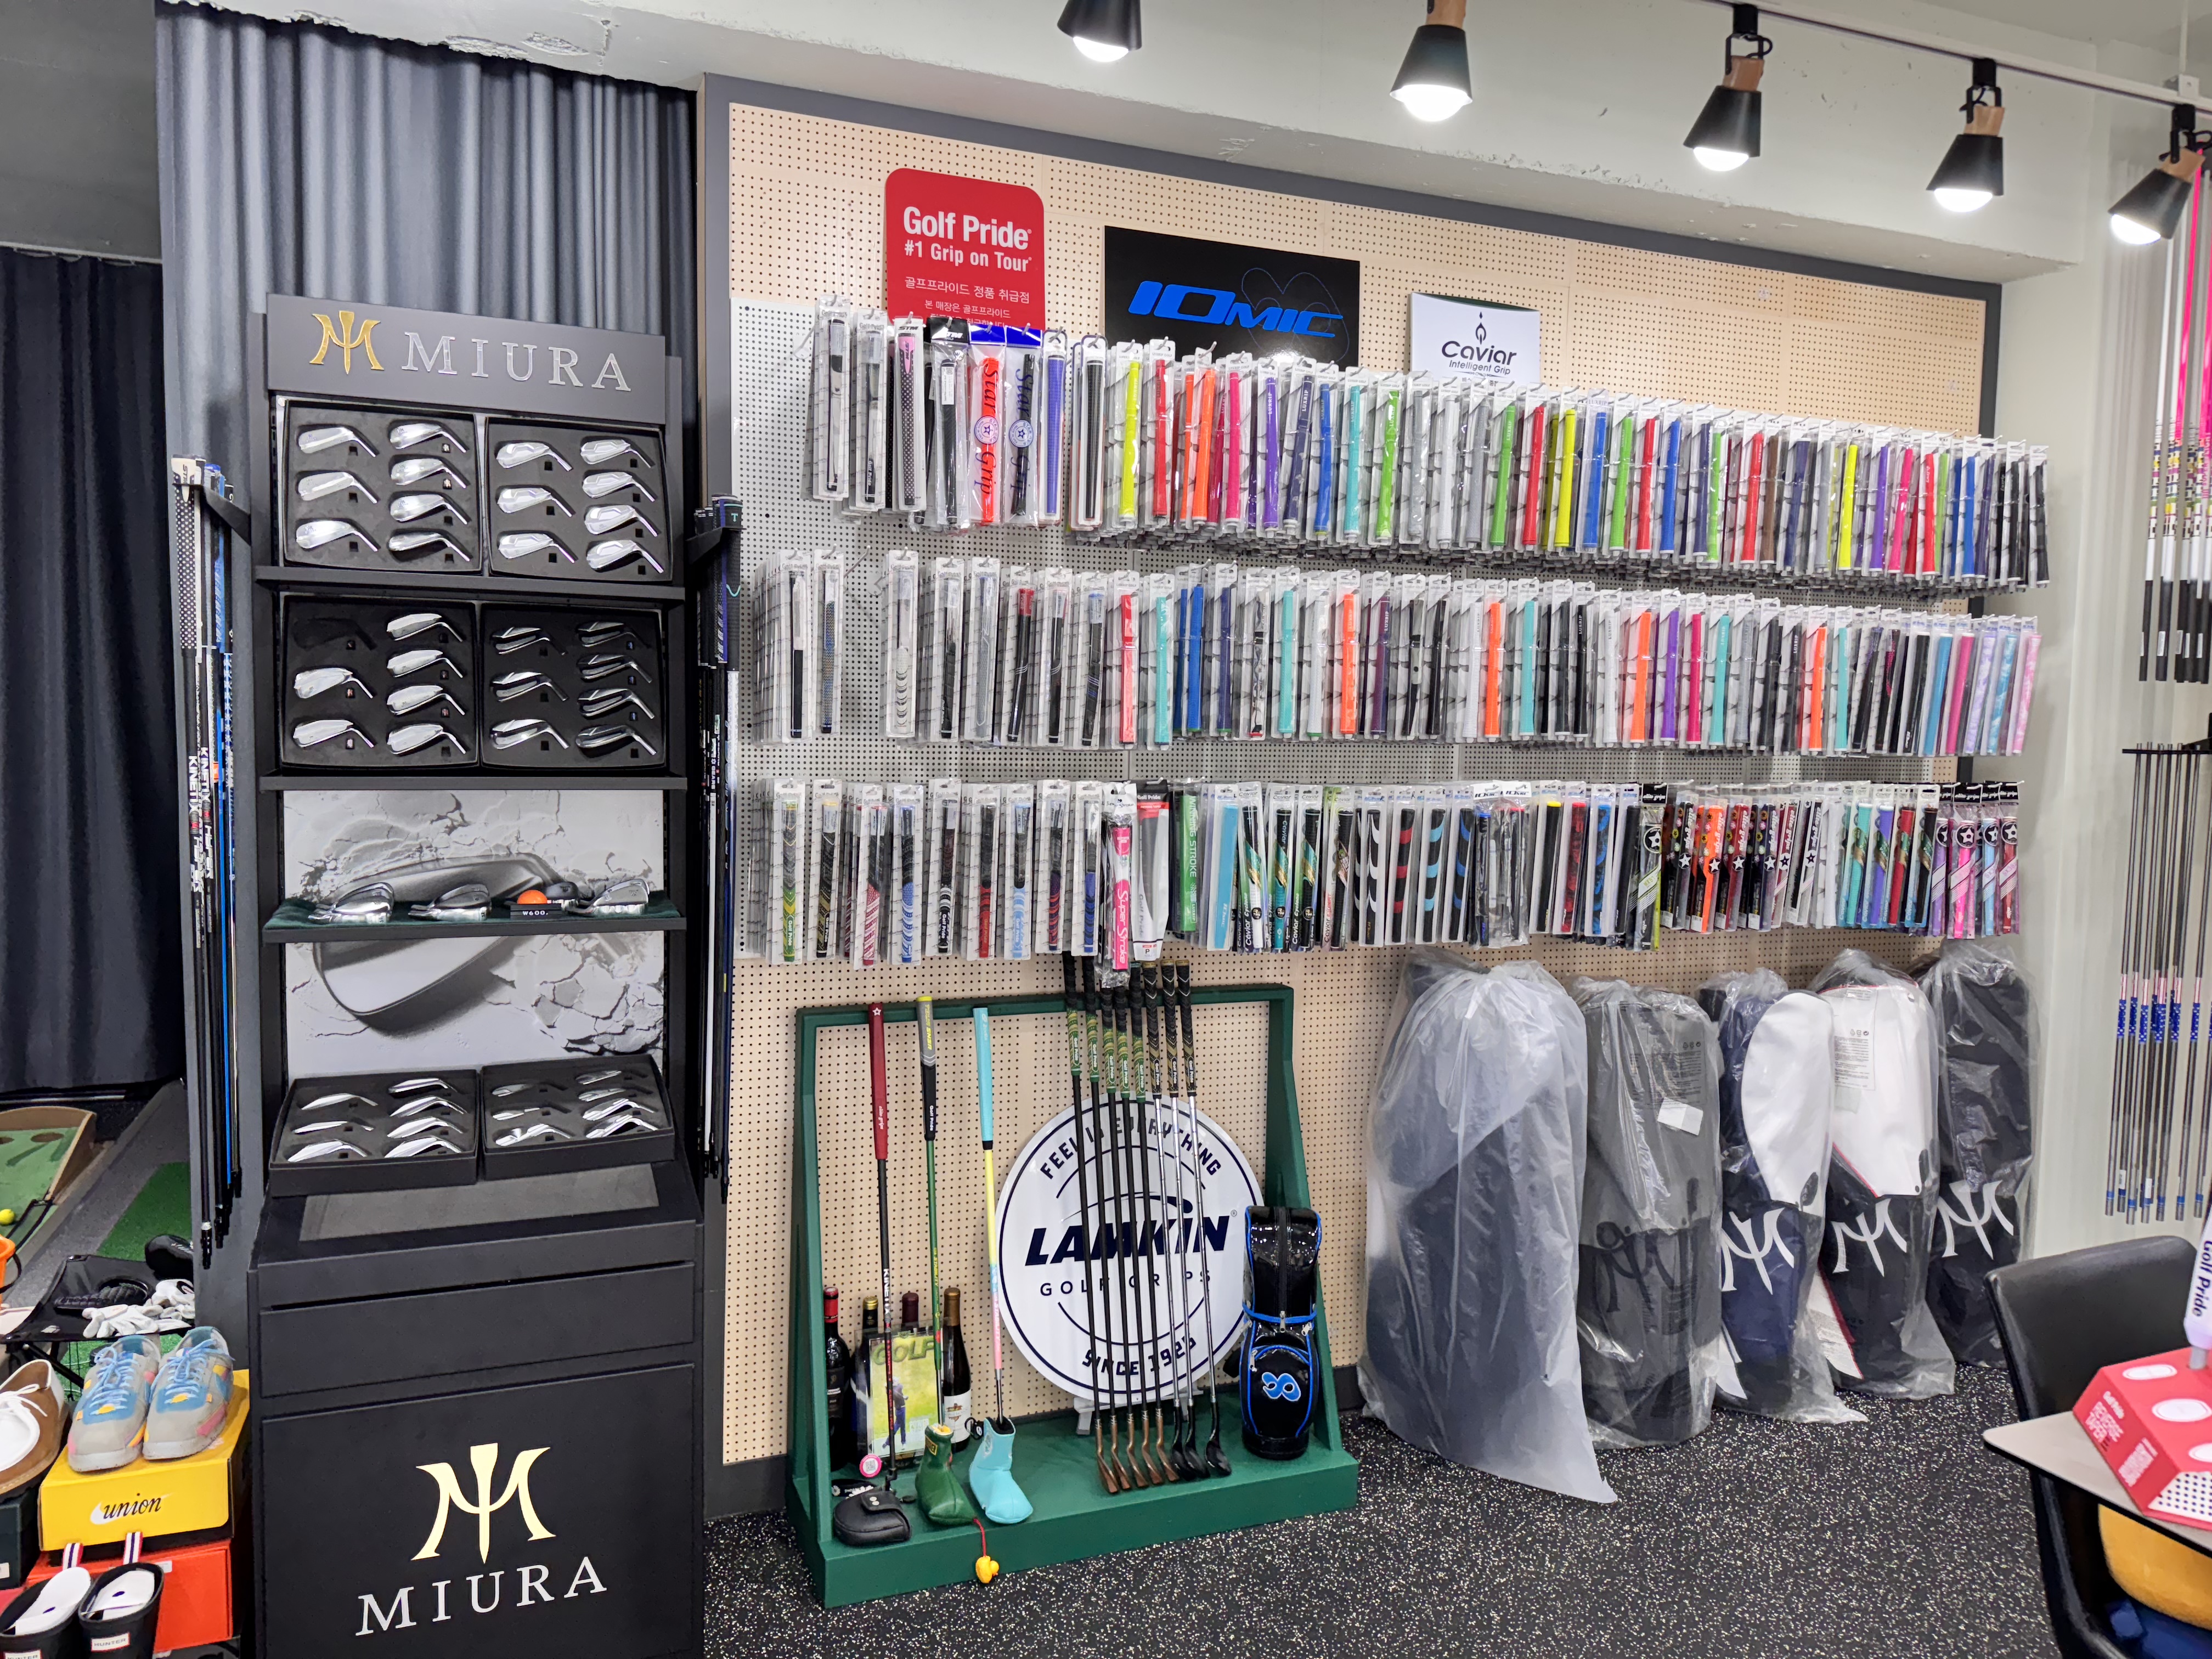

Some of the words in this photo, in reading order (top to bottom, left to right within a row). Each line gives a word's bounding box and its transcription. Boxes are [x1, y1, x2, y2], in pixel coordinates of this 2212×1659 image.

[903, 206, 956, 239] Golf
[904, 239, 922, 258] #1
[930, 243, 964, 267] Grip
[970, 251, 989, 267] on
[905, 276, 970, 295] 골프프라이드
[973, 285, 995, 300] 정품
[998, 289, 1030, 304] 취급점
[924, 300, 933, 309] 본
[935, 301, 960, 312] 매장은
[963, 303, 1011, 319] 골프프라이드
[1127, 281, 1344, 338] IOMIC
[401, 331, 631, 392] MIURA
[1441, 340, 1517, 366] Caviar
[1449, 359, 1492, 373] Intelligent
[1494, 365, 1510, 375] Grip
[984, 363, 999, 417] Star
[1015, 369, 1034, 417] Star
[974, 452, 996, 495] Grip
[1011, 454, 1030, 493] Grip
[1189, 795, 1198, 838] WINNING
[1117, 890, 1128, 924] Super
[1117, 924, 1128, 964] Stroke
[1025, 1216, 1230, 1266] LAMKIN
[2192, 1275, 2211, 1317] Pride
[2092, 1401, 2124, 1442] REVERSE
[103, 1493, 161, 1520] union
[355, 1556, 607, 1637] MIURA
[94, 1638, 126, 1646] HUNTER
